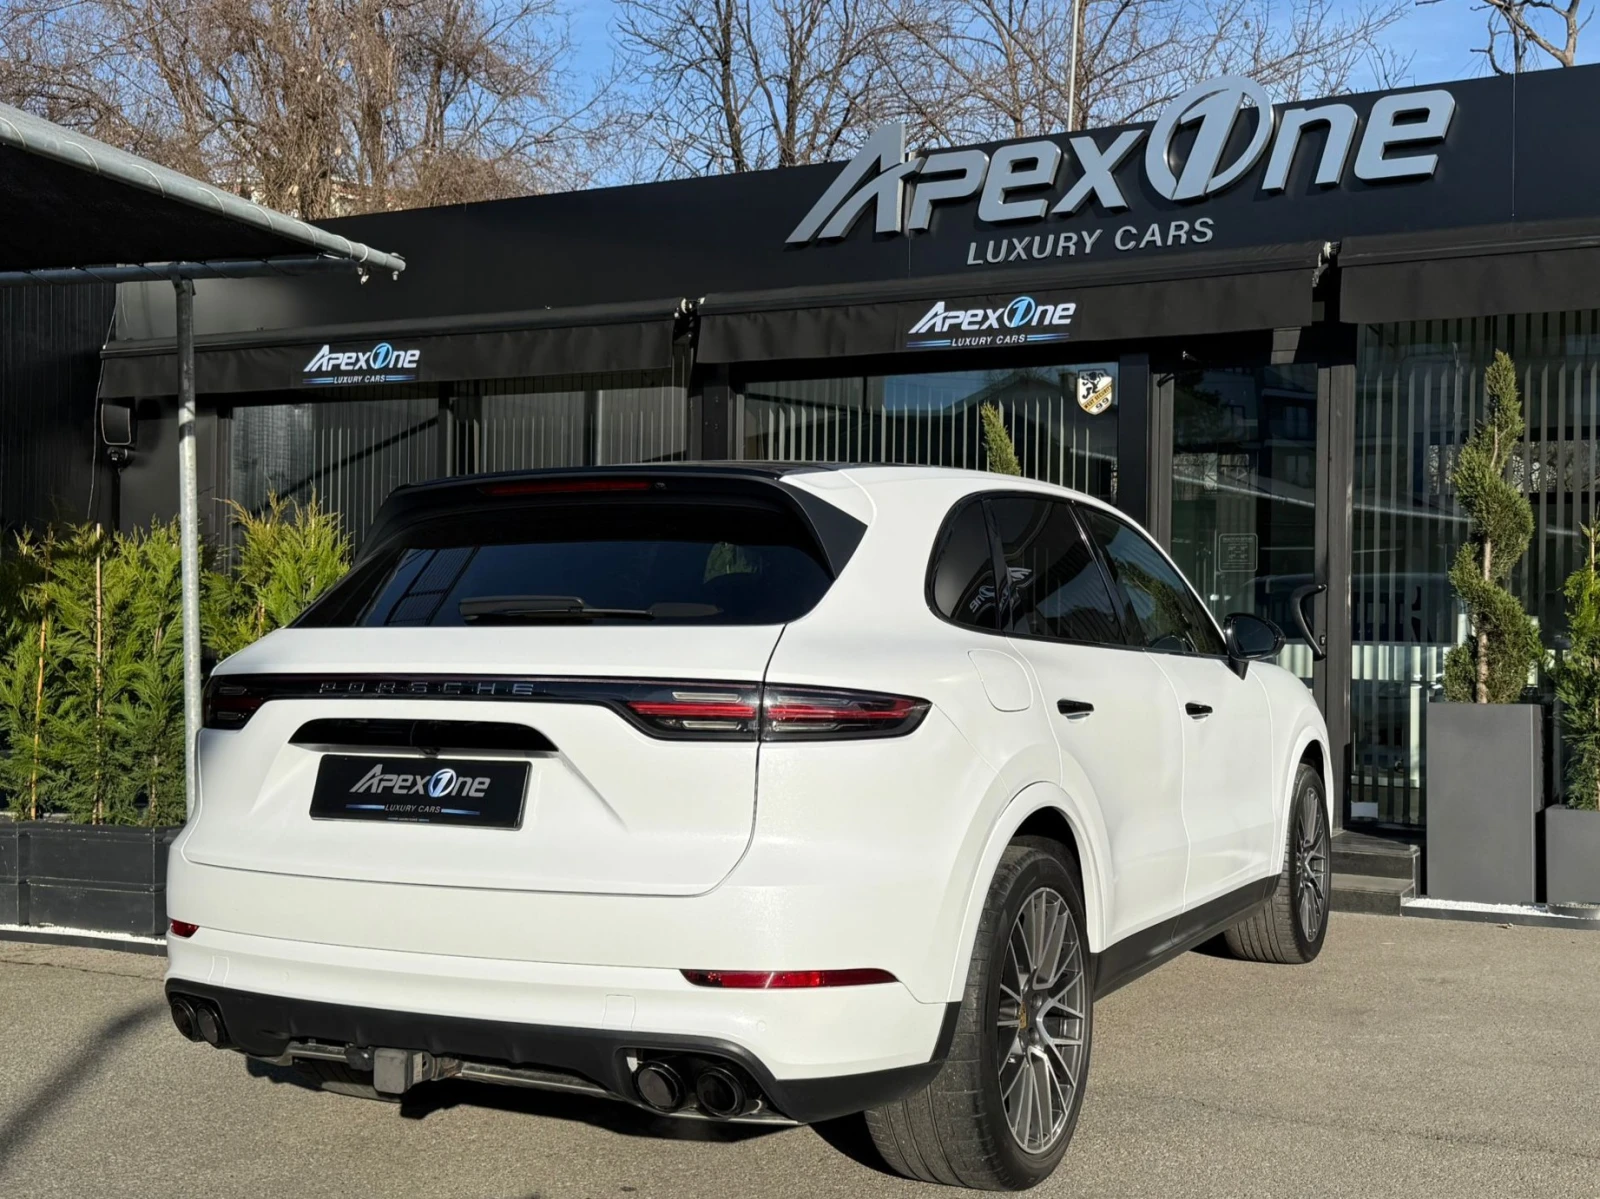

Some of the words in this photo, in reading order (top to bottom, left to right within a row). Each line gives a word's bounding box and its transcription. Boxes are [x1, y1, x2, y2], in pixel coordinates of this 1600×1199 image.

[966, 228, 1103, 266] LUXURY
[1113, 216, 1215, 252] CARS
[951, 335, 993, 348] LUXURY
[996, 333, 1026, 345] CARS
[333, 375, 363, 385] LUXURY
[364, 374, 386, 383] CARS
[318, 681, 535, 696] PORSCHE
[384, 803, 418, 812] LUXURY
[418, 805, 441, 814] CARS
